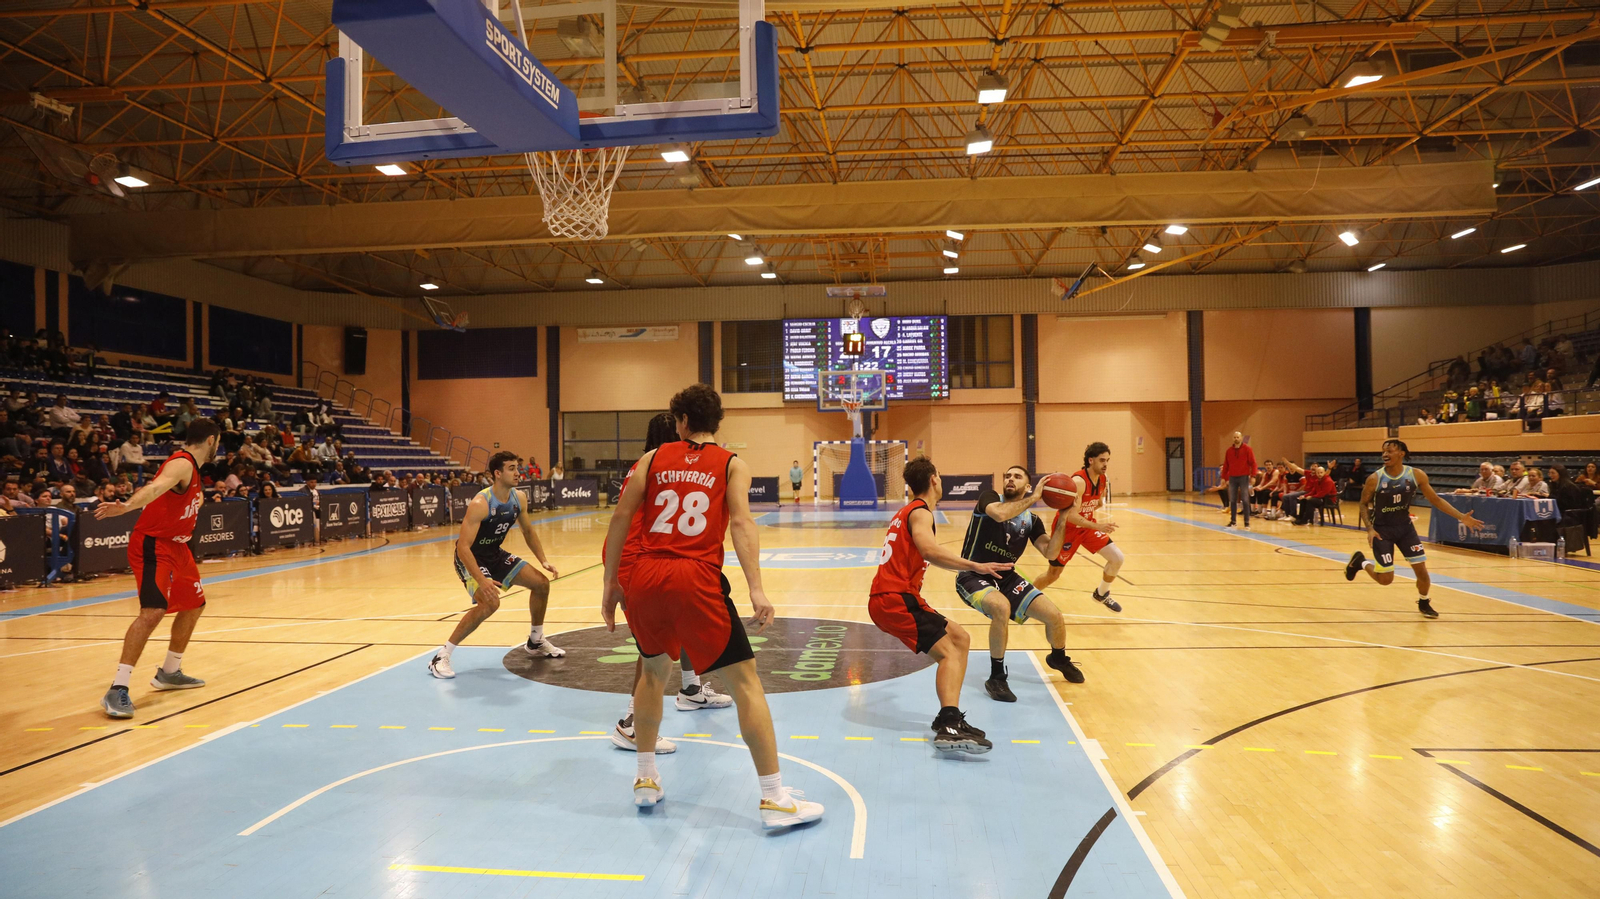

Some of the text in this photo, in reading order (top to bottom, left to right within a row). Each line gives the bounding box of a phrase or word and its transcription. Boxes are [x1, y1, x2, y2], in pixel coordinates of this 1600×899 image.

[486, 18, 560, 104] SPORT SYSTEM
[872, 346, 891, 359] 17
[854, 362, 879, 370] 1:22
[655, 470, 716, 489] ECHEVERRÍA
[1393, 494, 1401, 504] 10
[284, 503, 303, 526] ice
[650, 490, 710, 536] 28
[494, 522, 510, 534] 29
[94, 533, 130, 548] surpool
[199, 532, 234, 543] ASESORES
[1382, 553, 1392, 564] 10
[770, 625, 848, 681] damex.io
